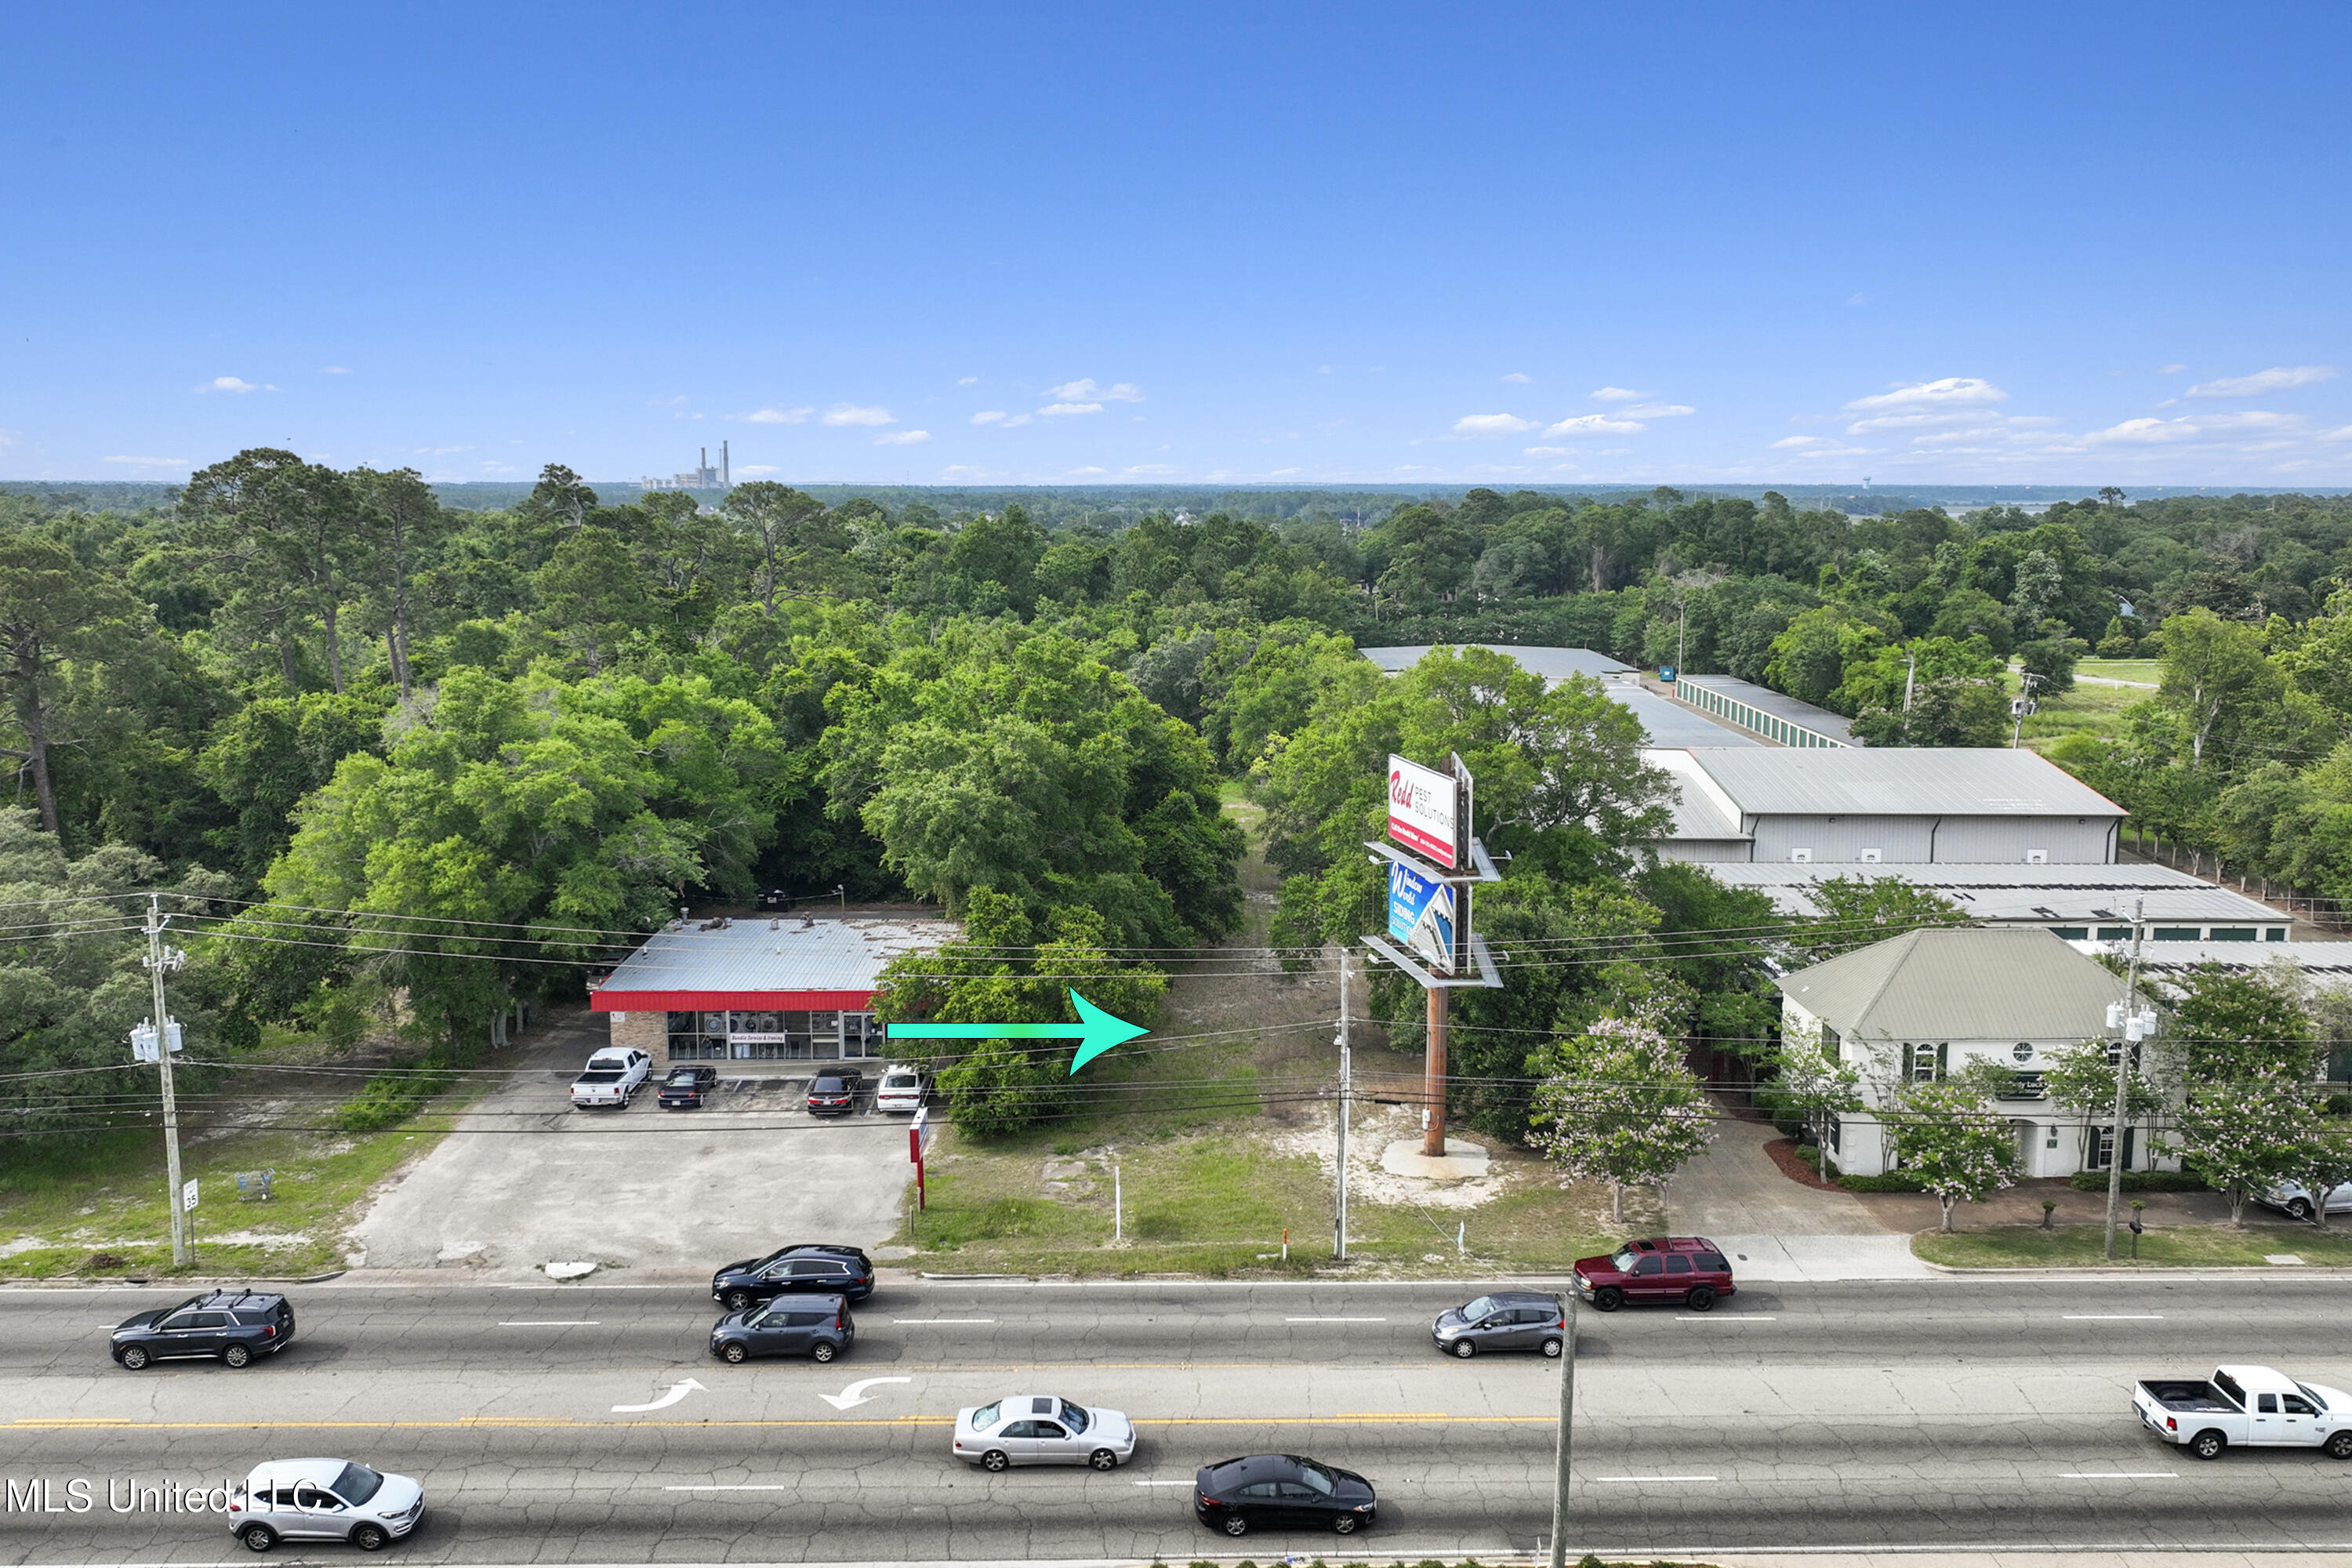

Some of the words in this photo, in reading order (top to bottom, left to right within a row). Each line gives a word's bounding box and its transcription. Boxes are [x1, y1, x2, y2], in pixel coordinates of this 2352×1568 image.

[1391, 770, 1414, 809] Redd
[1415, 786, 1432, 803] PEST
[1415, 801, 1454, 829] SOLUTIONS
[1392, 861, 1423, 898] Window
[1393, 901, 1415, 925] SIDING
[187, 1194, 197, 1208] 35
